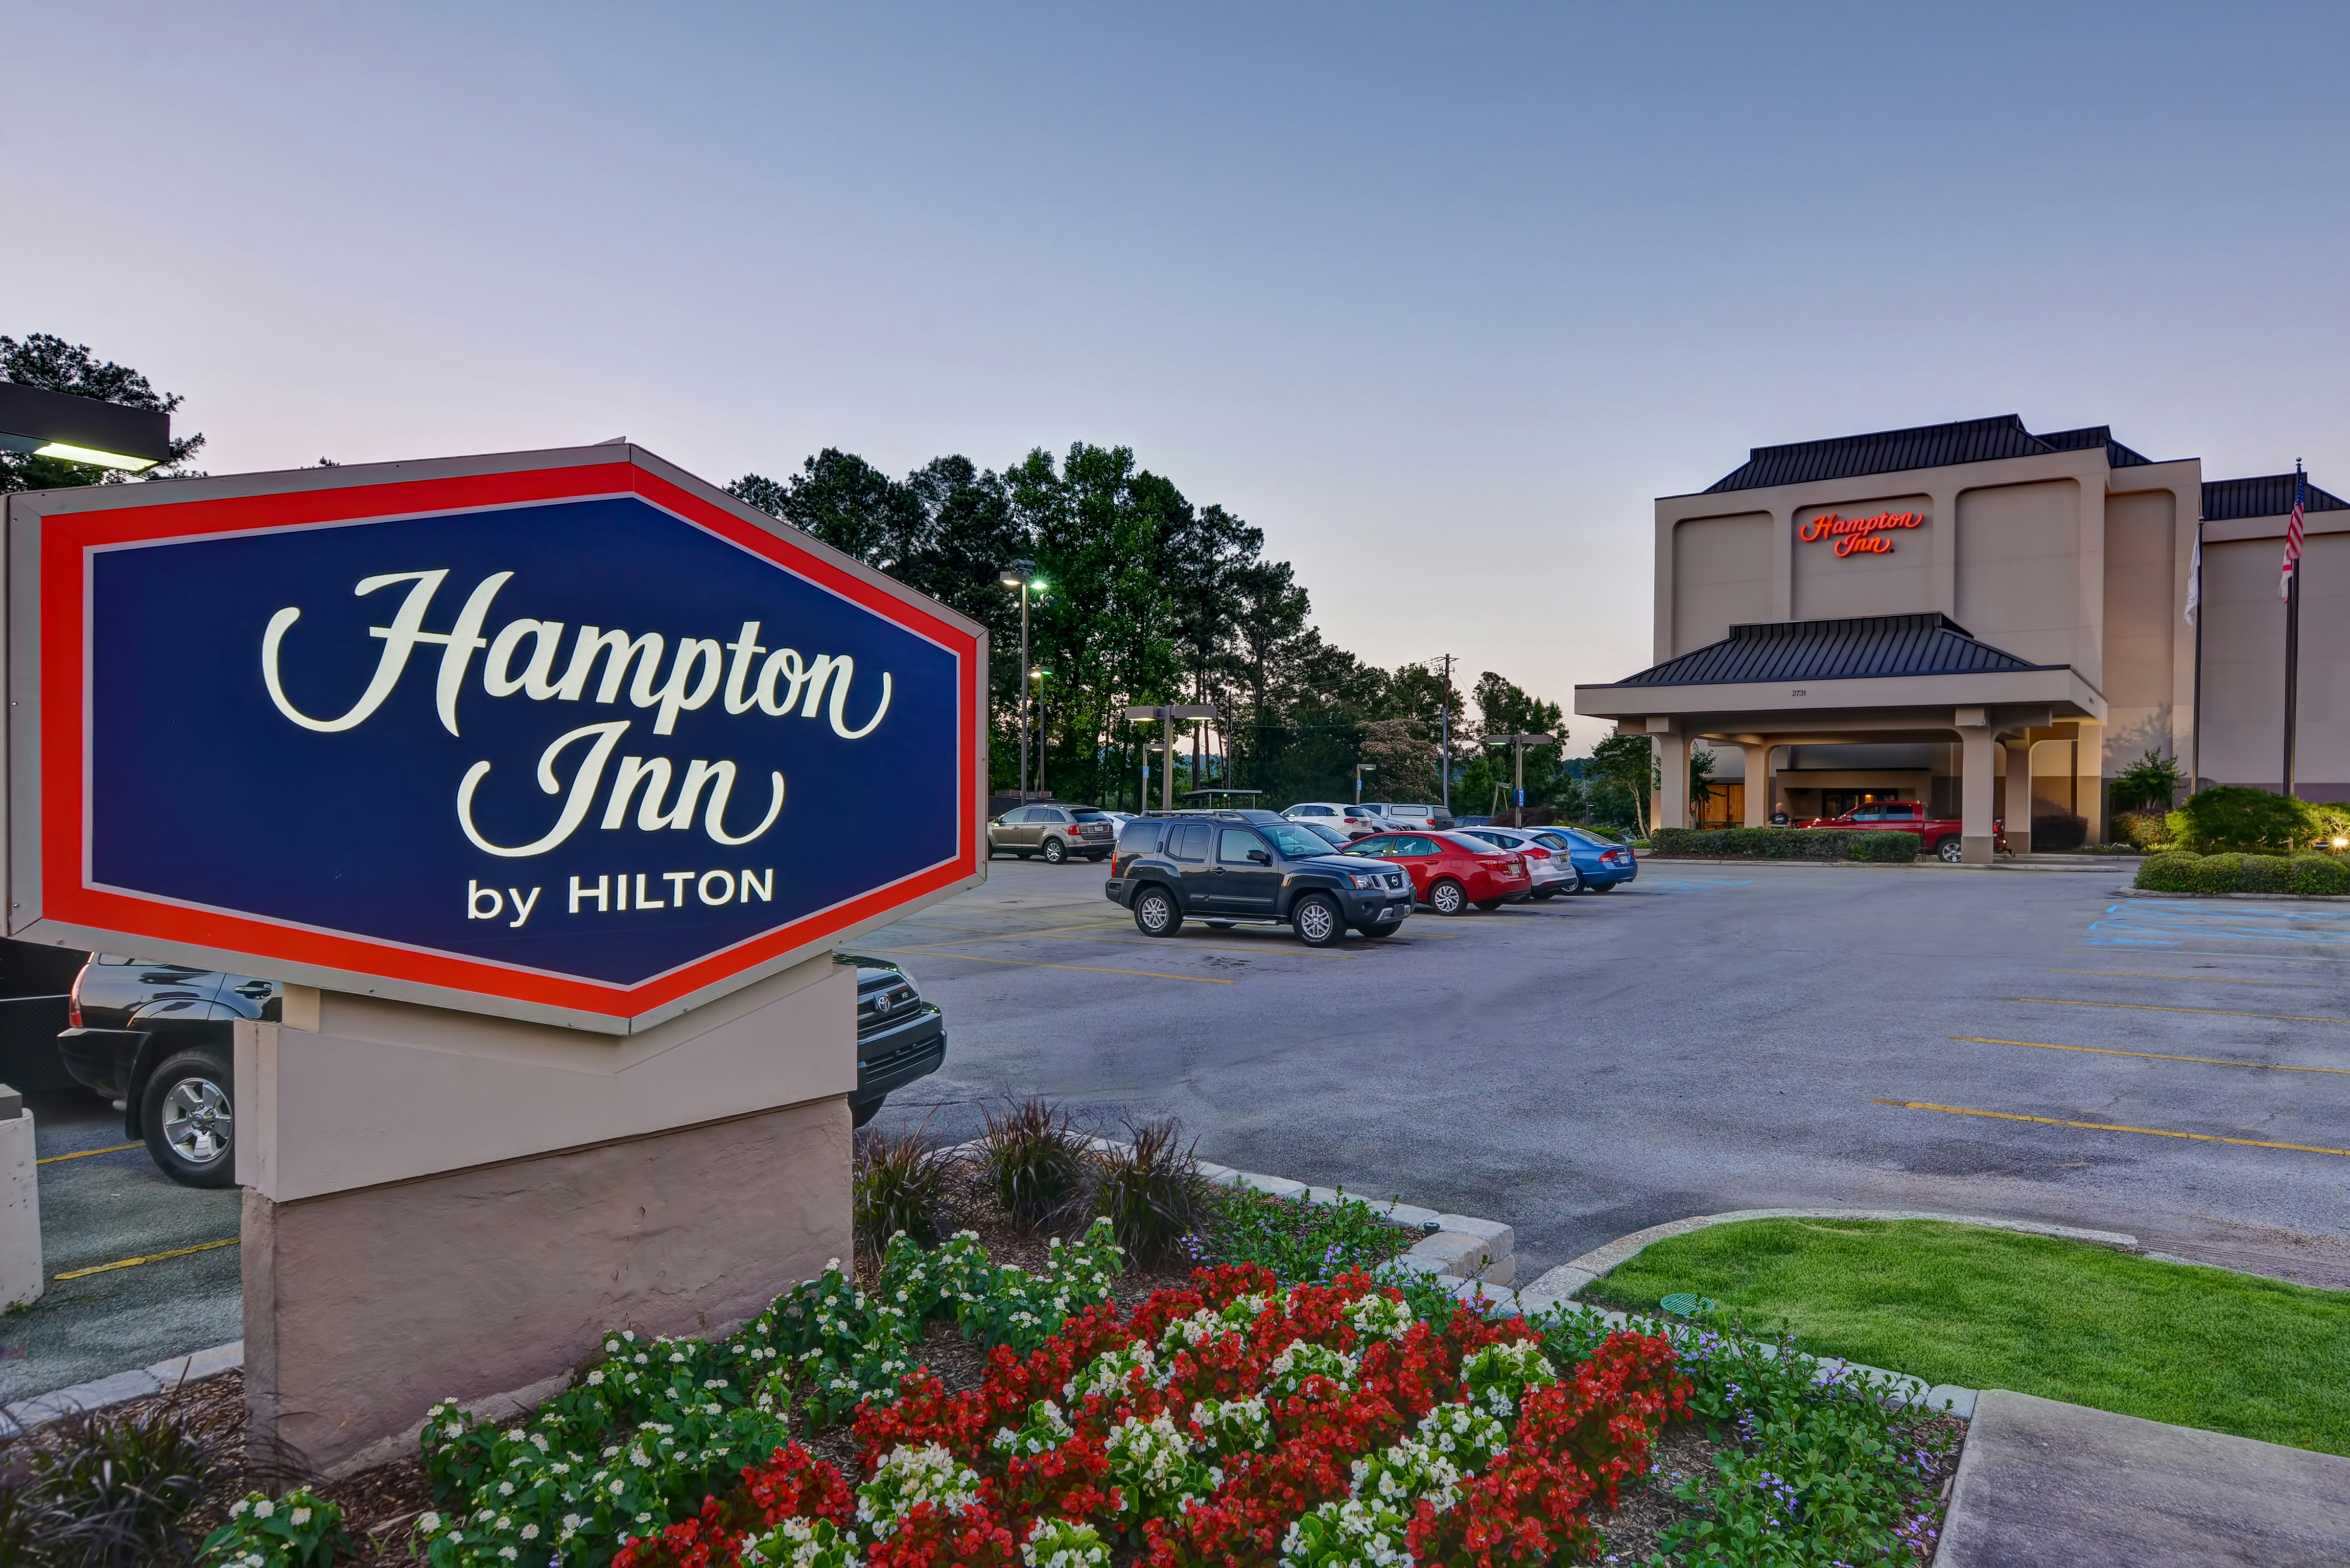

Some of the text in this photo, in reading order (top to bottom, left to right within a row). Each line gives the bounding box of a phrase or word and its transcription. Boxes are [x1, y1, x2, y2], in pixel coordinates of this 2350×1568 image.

[1799, 511, 1923, 542] Hampton
[1834, 532, 1891, 558] Inn
[262, 569, 891, 739] Hampton
[457, 720, 784, 857] Inn
[467, 869, 773, 928] by HILTON
